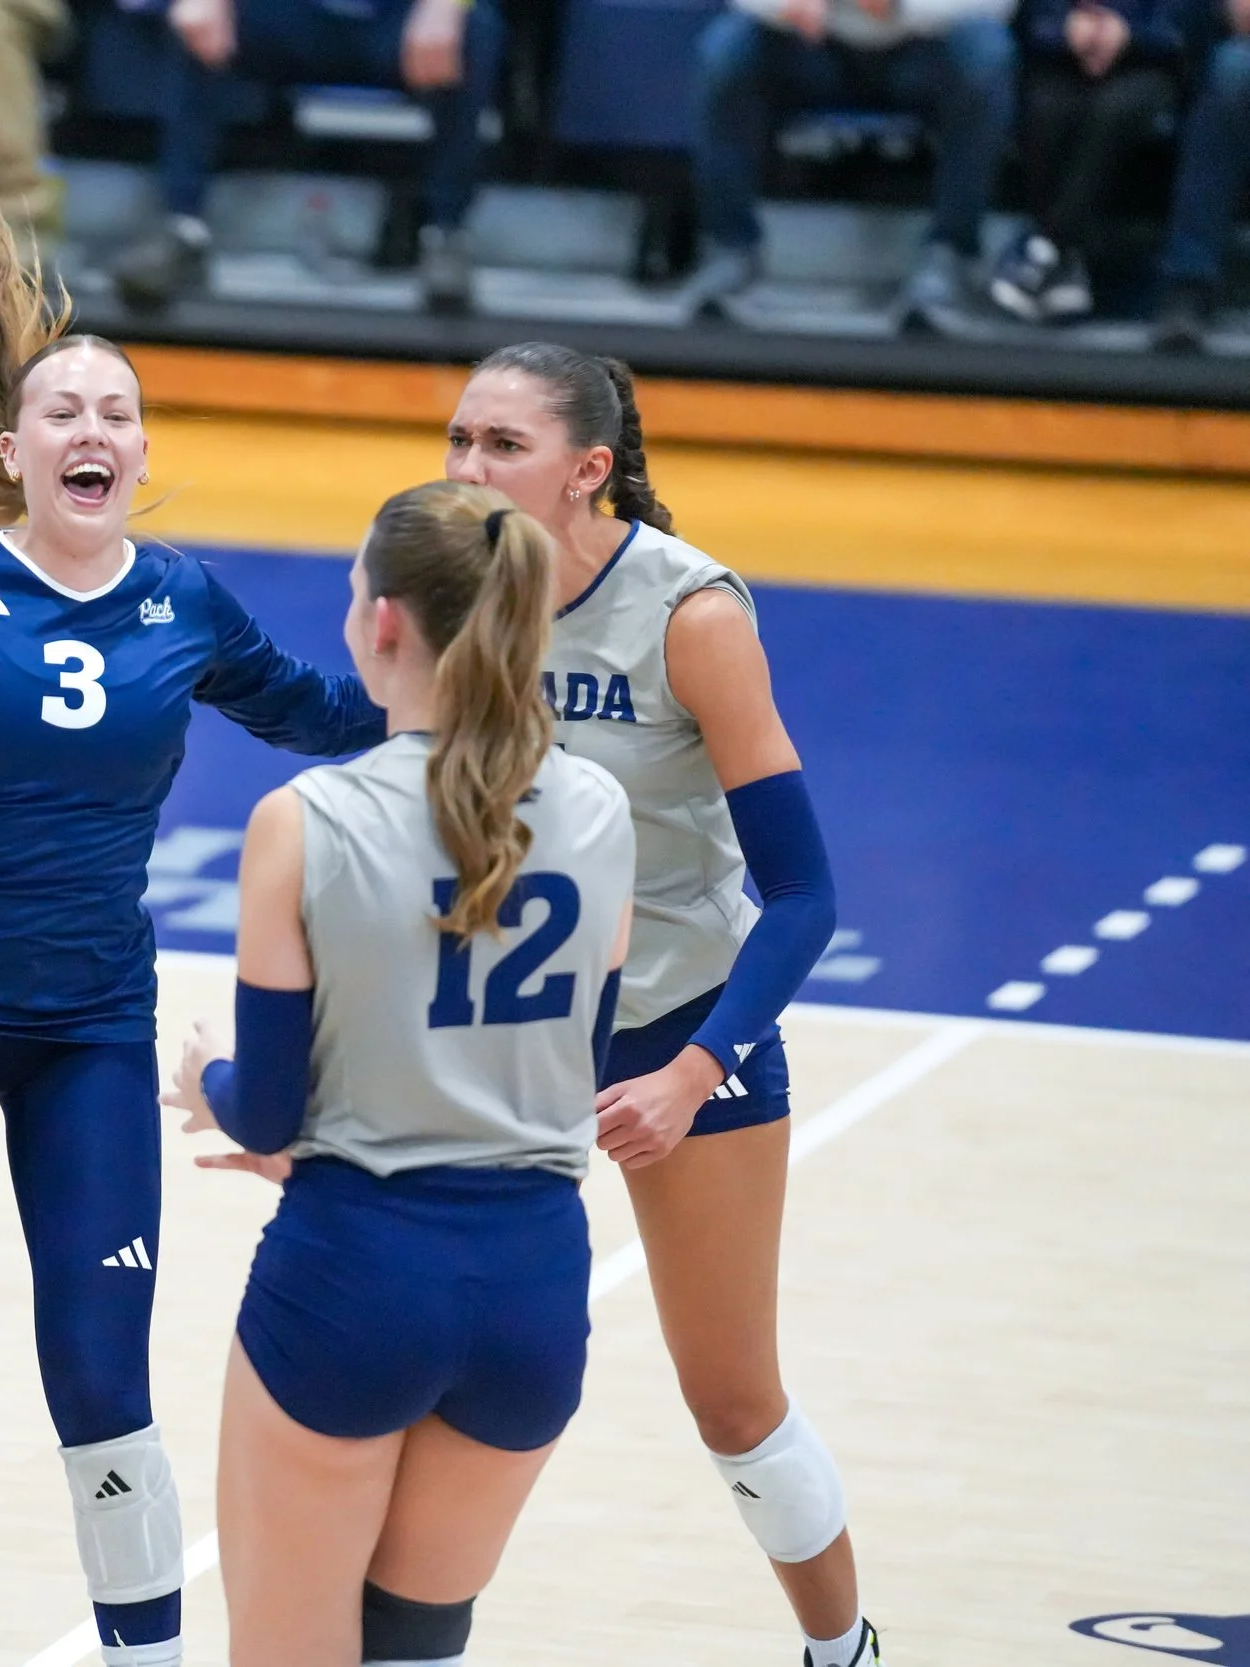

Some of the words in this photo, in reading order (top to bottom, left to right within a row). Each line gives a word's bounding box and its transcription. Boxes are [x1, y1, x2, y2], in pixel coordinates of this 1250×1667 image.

[138, 596, 175, 626] Pack
[41, 640, 107, 729] 3
[428, 871, 581, 1029] 12
